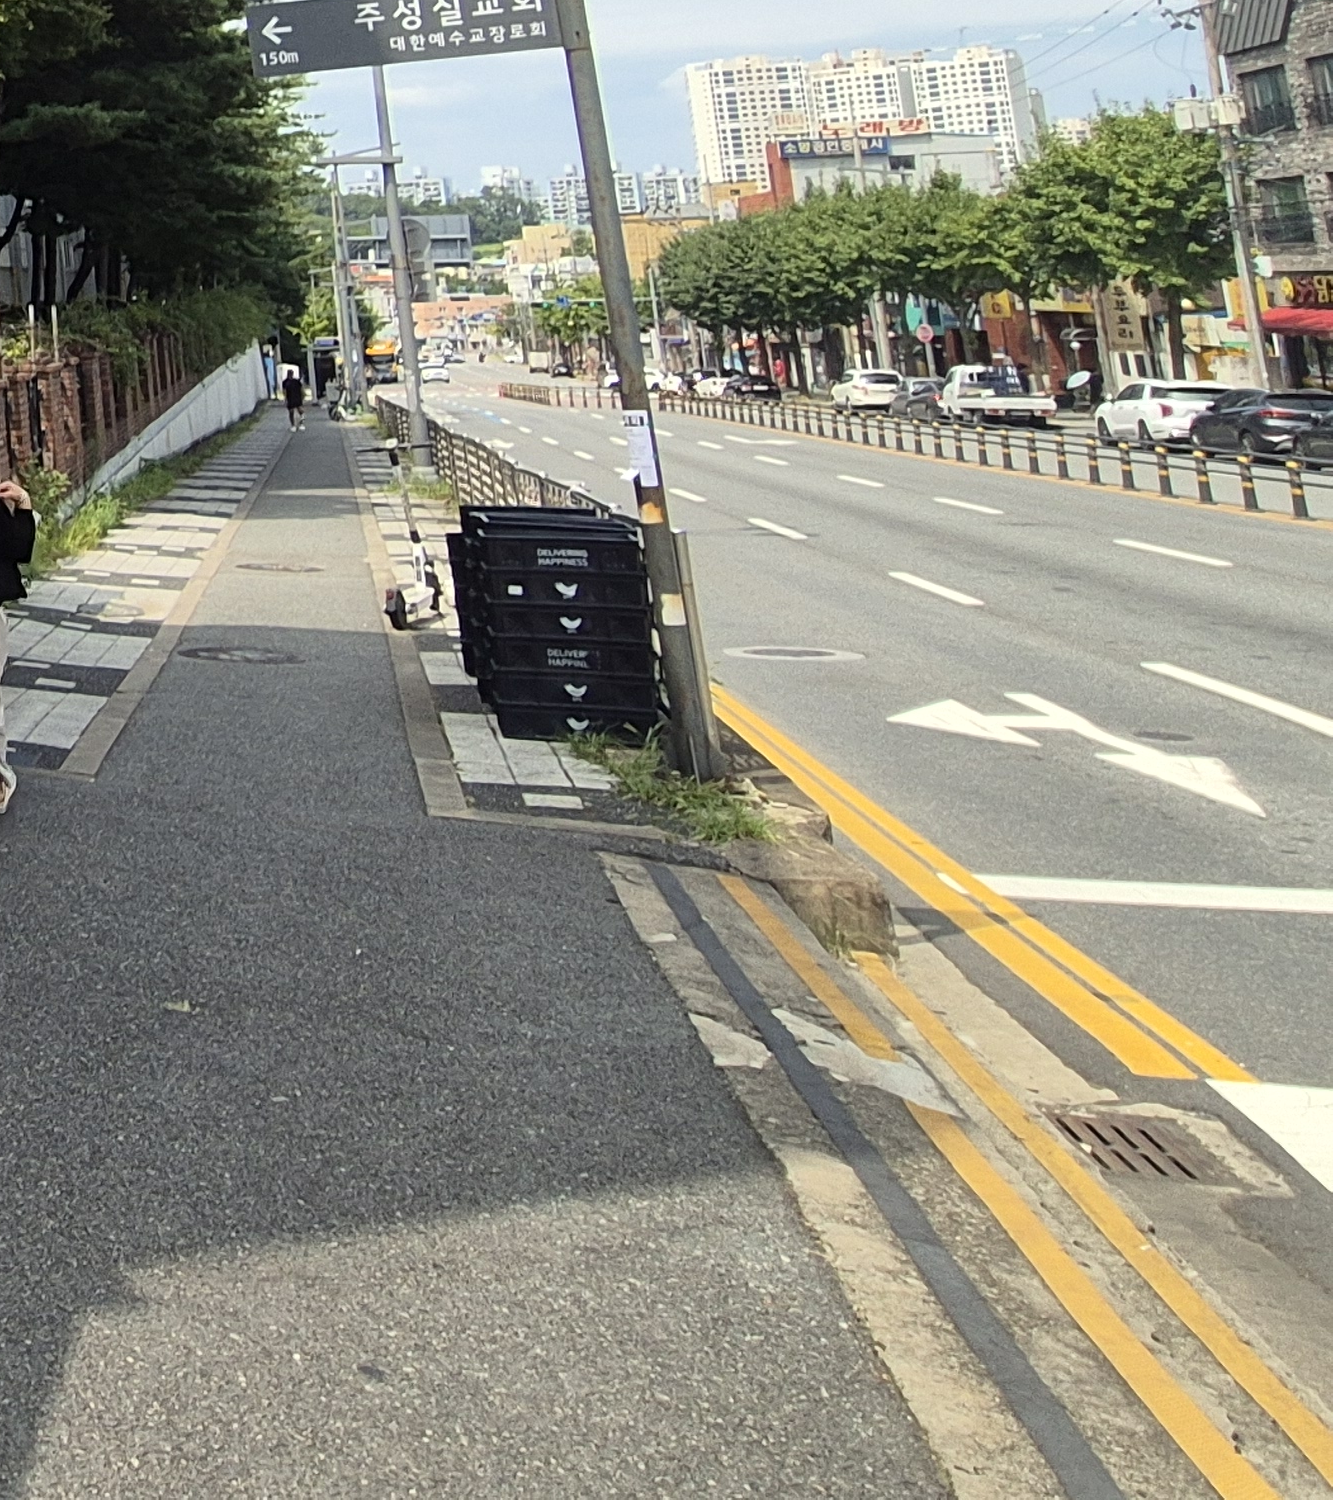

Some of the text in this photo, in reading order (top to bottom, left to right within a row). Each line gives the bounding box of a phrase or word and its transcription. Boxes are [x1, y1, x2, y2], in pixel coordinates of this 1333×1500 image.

[389, 20, 547, 52] 대한예수교장로회
[259, 50, 299, 66] 150m
[537, 557, 588, 567] HAPPINESS
